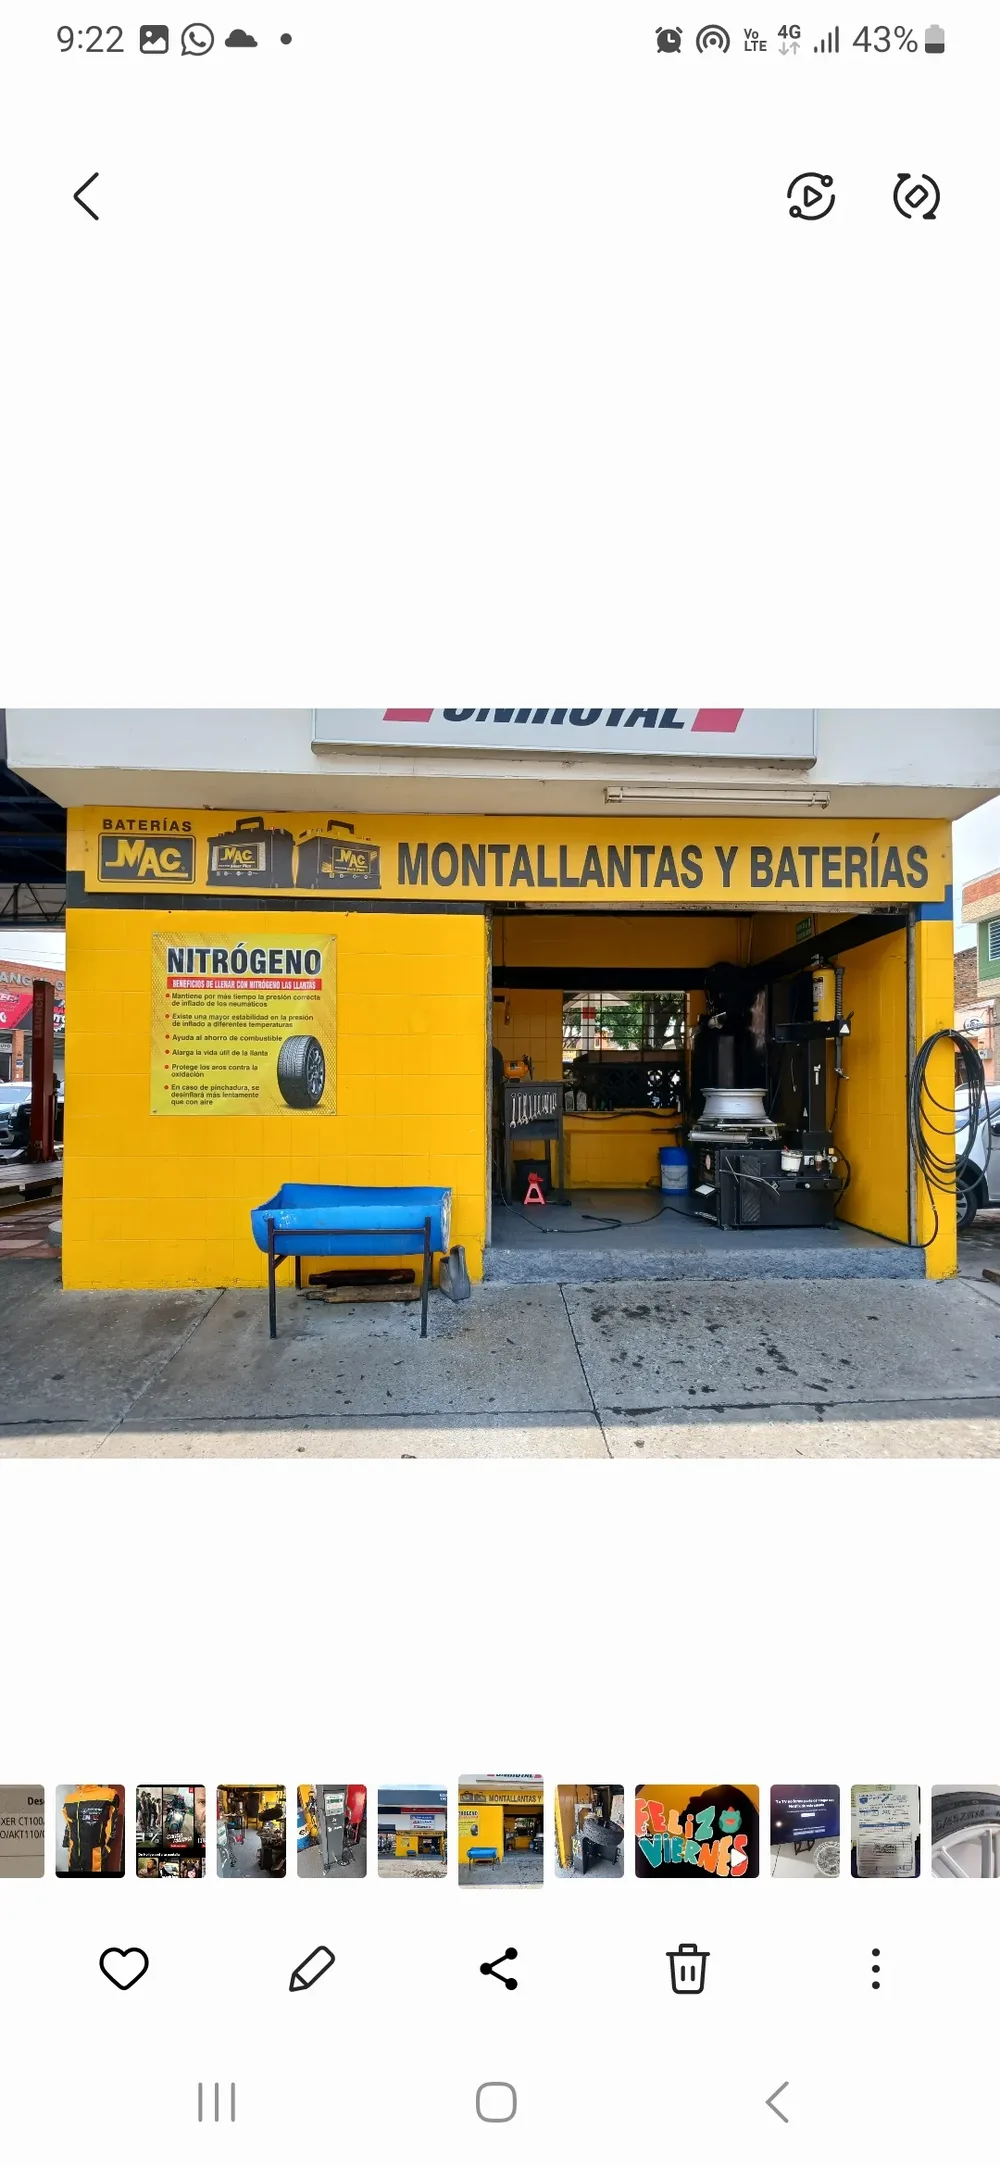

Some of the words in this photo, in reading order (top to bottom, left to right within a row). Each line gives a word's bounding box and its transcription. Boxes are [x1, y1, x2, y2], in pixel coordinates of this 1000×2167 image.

[103, 818, 191, 832] BATERÍAS
[105, 839, 188, 877] MAC
[220, 846, 255, 865] MAC
[335, 849, 368, 868] MAC
[397, 842, 704, 889] MONTALLANTAS
[714, 845, 738, 888] Y
[750, 833, 929, 889] BATERÍAS
[167, 943, 321, 975] NITRÓGENO
[172, 980, 205, 988] BENEFICIOS
[205, 980, 213, 988] DE
[214, 980, 235, 989] LLENAR
[236, 980, 248, 989] CON
[249, 979, 280, 989] NITRÓGENO
[281, 981, 292, 990] LAS
[293, 981, 316, 990] LLANTAS
[233, 993, 256, 1001] tiempo
[288, 1014, 313, 1022] presión
[172, 1034, 194, 1042] Ayuda
[172, 1049, 194, 1057] Alarga
[171, 1064, 198, 1072] Protege
[18, 1816, 44, 1826] CT100
